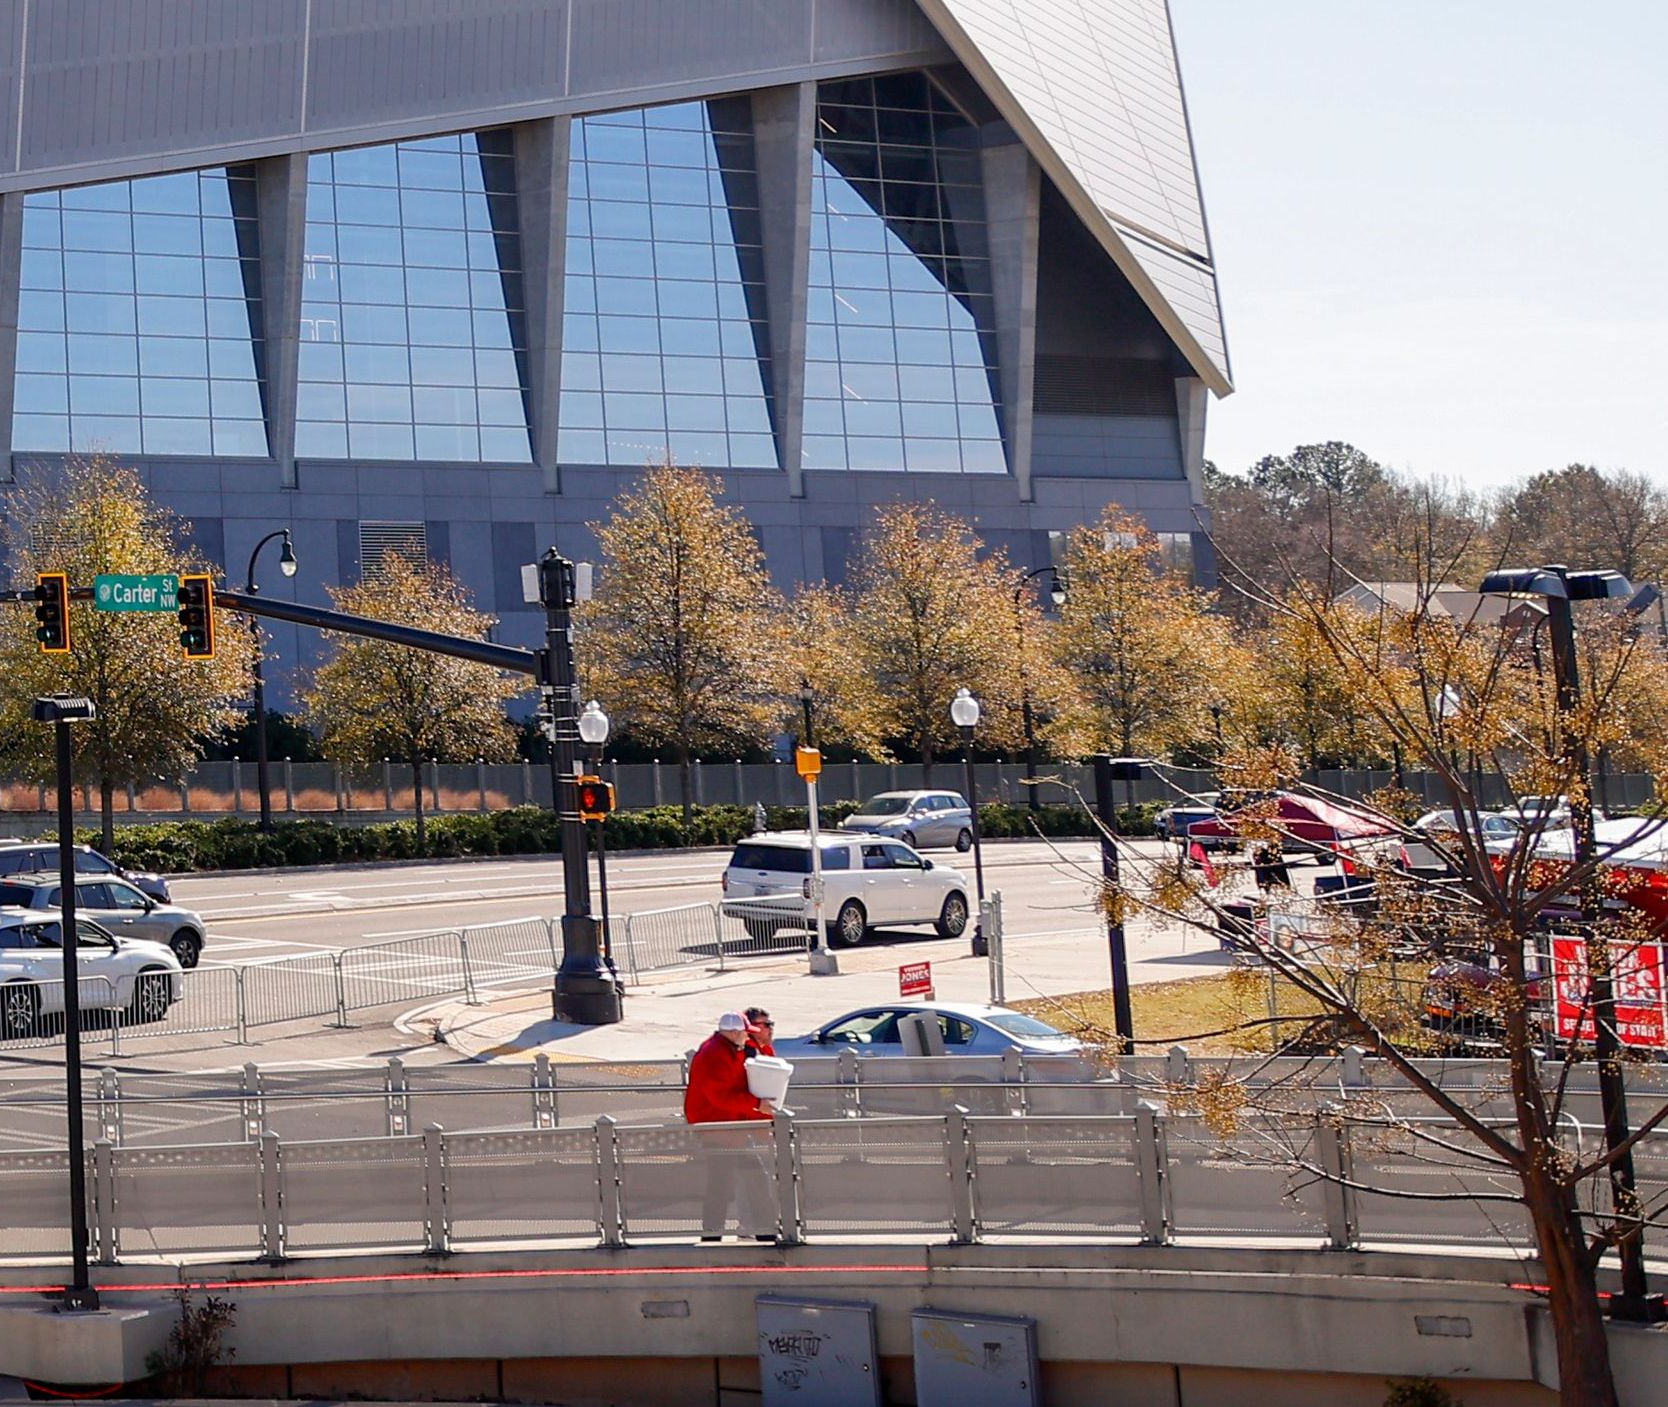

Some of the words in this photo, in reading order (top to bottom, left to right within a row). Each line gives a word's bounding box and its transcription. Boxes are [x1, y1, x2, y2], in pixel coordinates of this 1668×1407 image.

[113, 583, 158, 604] Carter
[162, 578, 173, 593] St
[160, 594, 177, 608] NW
[900, 969, 930, 983] JONES
